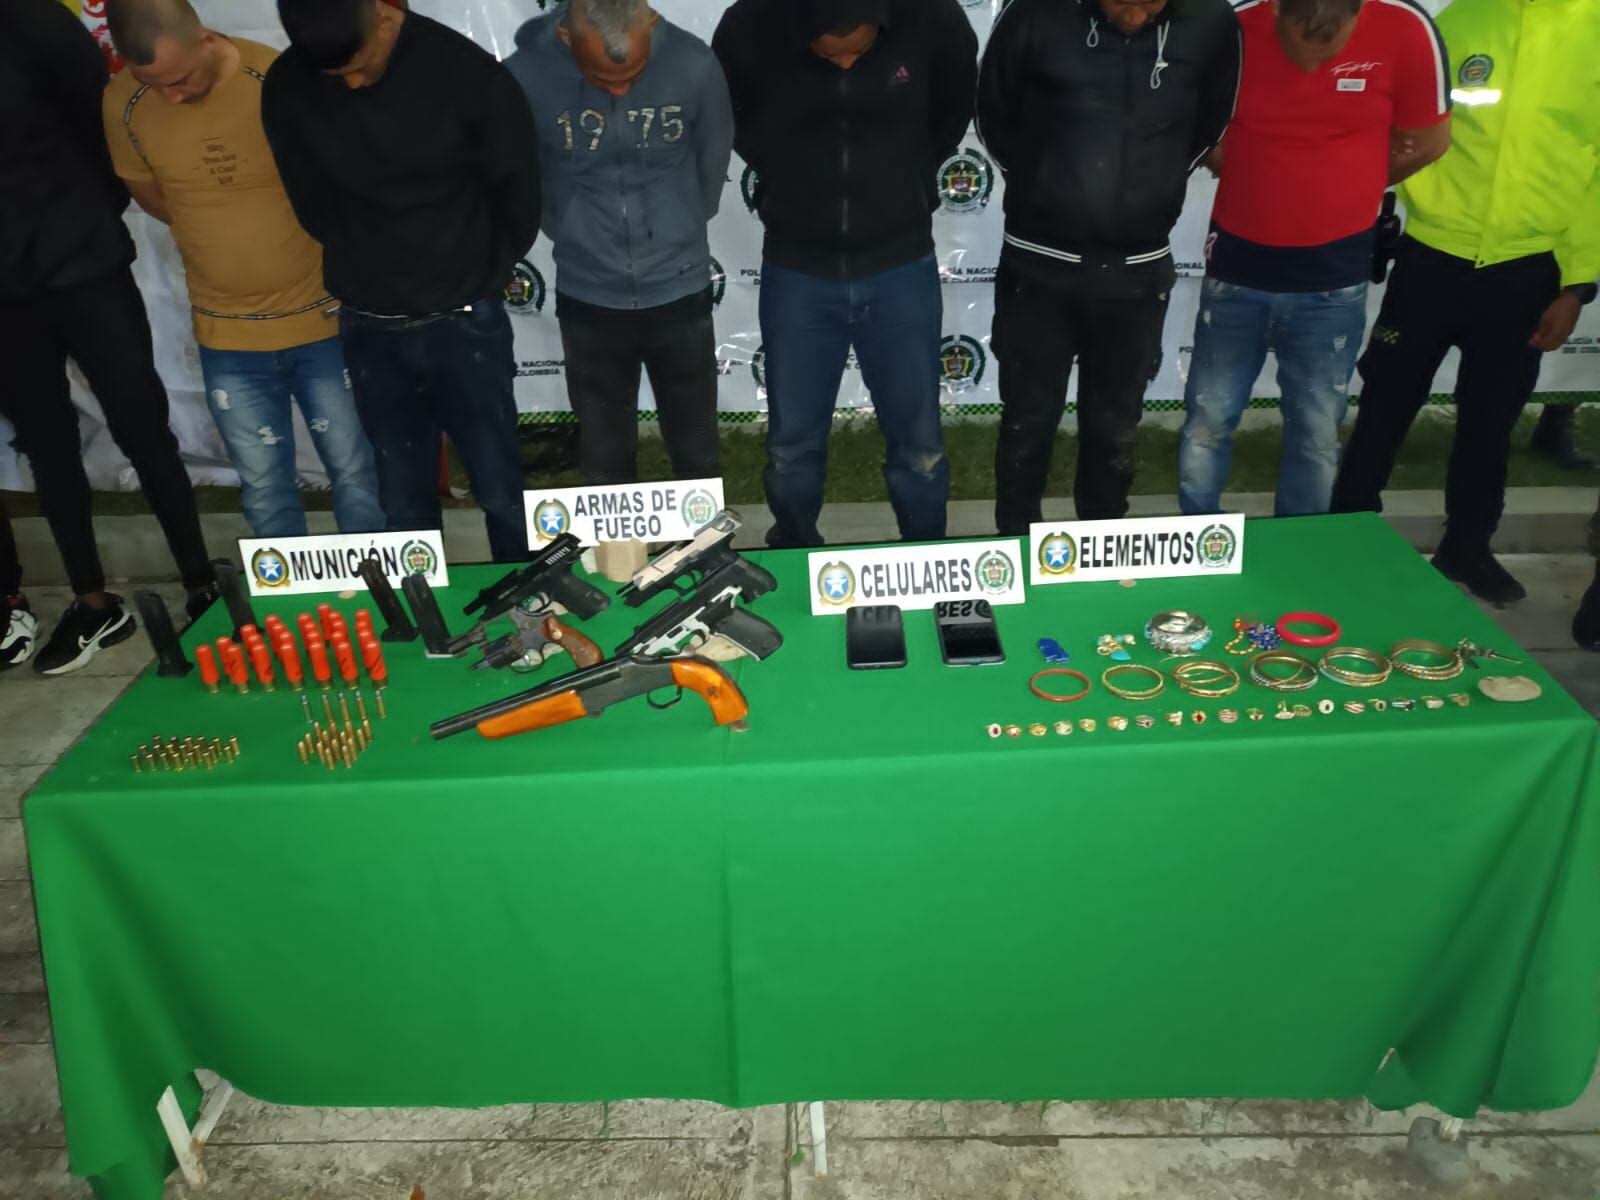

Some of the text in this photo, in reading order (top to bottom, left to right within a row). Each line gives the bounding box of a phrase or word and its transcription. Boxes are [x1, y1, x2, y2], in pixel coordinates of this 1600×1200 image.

[574, 489, 677, 517] ARMAS DE
[594, 514, 662, 540] FUEGO
[1080, 531, 1195, 569] ELEMENTOS
[860, 558, 972, 599] CELULARES
